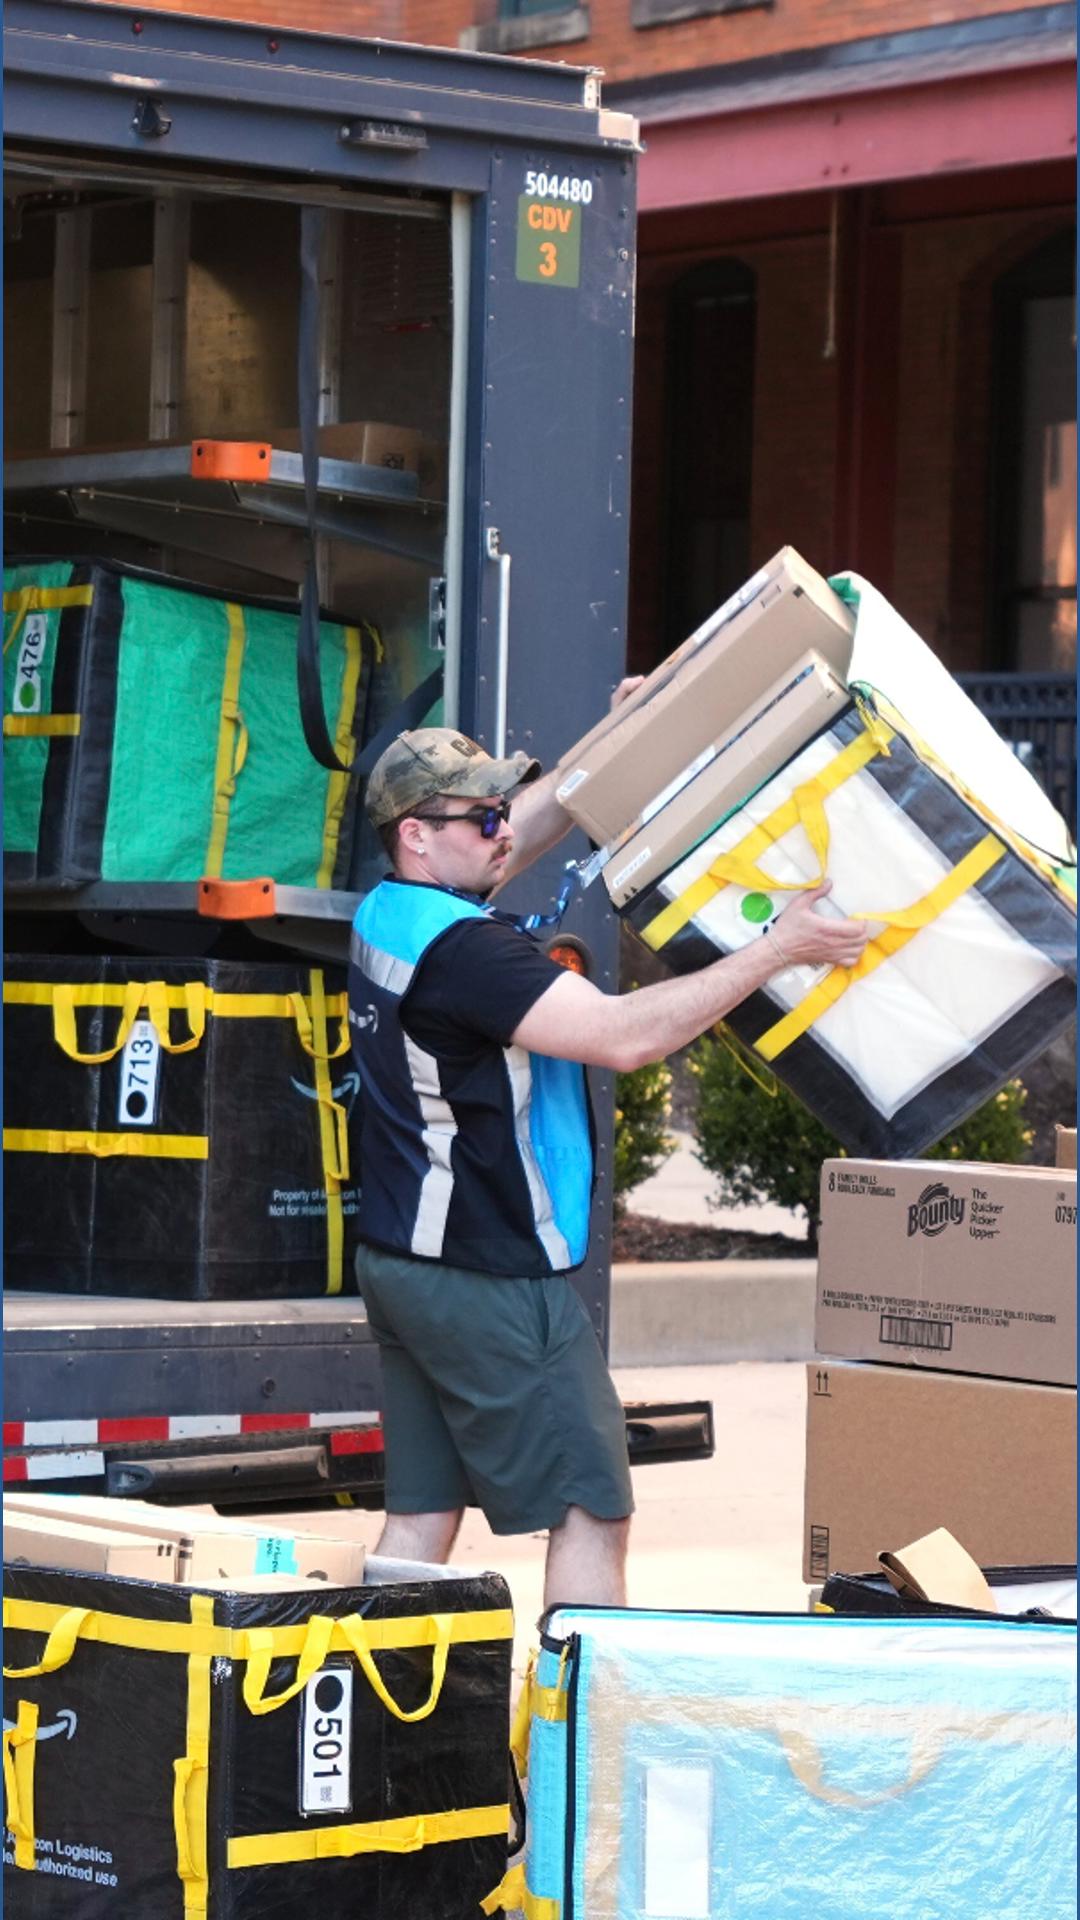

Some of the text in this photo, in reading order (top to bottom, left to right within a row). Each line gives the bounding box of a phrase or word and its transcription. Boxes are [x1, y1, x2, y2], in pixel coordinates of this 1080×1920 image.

[525, 171, 592, 204] 504480
[528, 203, 572, 233] CDV
[538, 242, 557, 277] 3
[21, 633, 41, 679] 476
[128, 1040, 153, 1087] 713
[273, 1189, 310, 1202] Property
[971, 1187, 987, 1200] The
[971, 1201, 1004, 1214] Quicker
[907, 1196, 965, 1237] Bounty
[970, 1213, 996, 1226] Picker
[313, 1717, 342, 1778] 501
[56, 1840, 113, 1864] Logistics
[95, 1871, 118, 1887] use
